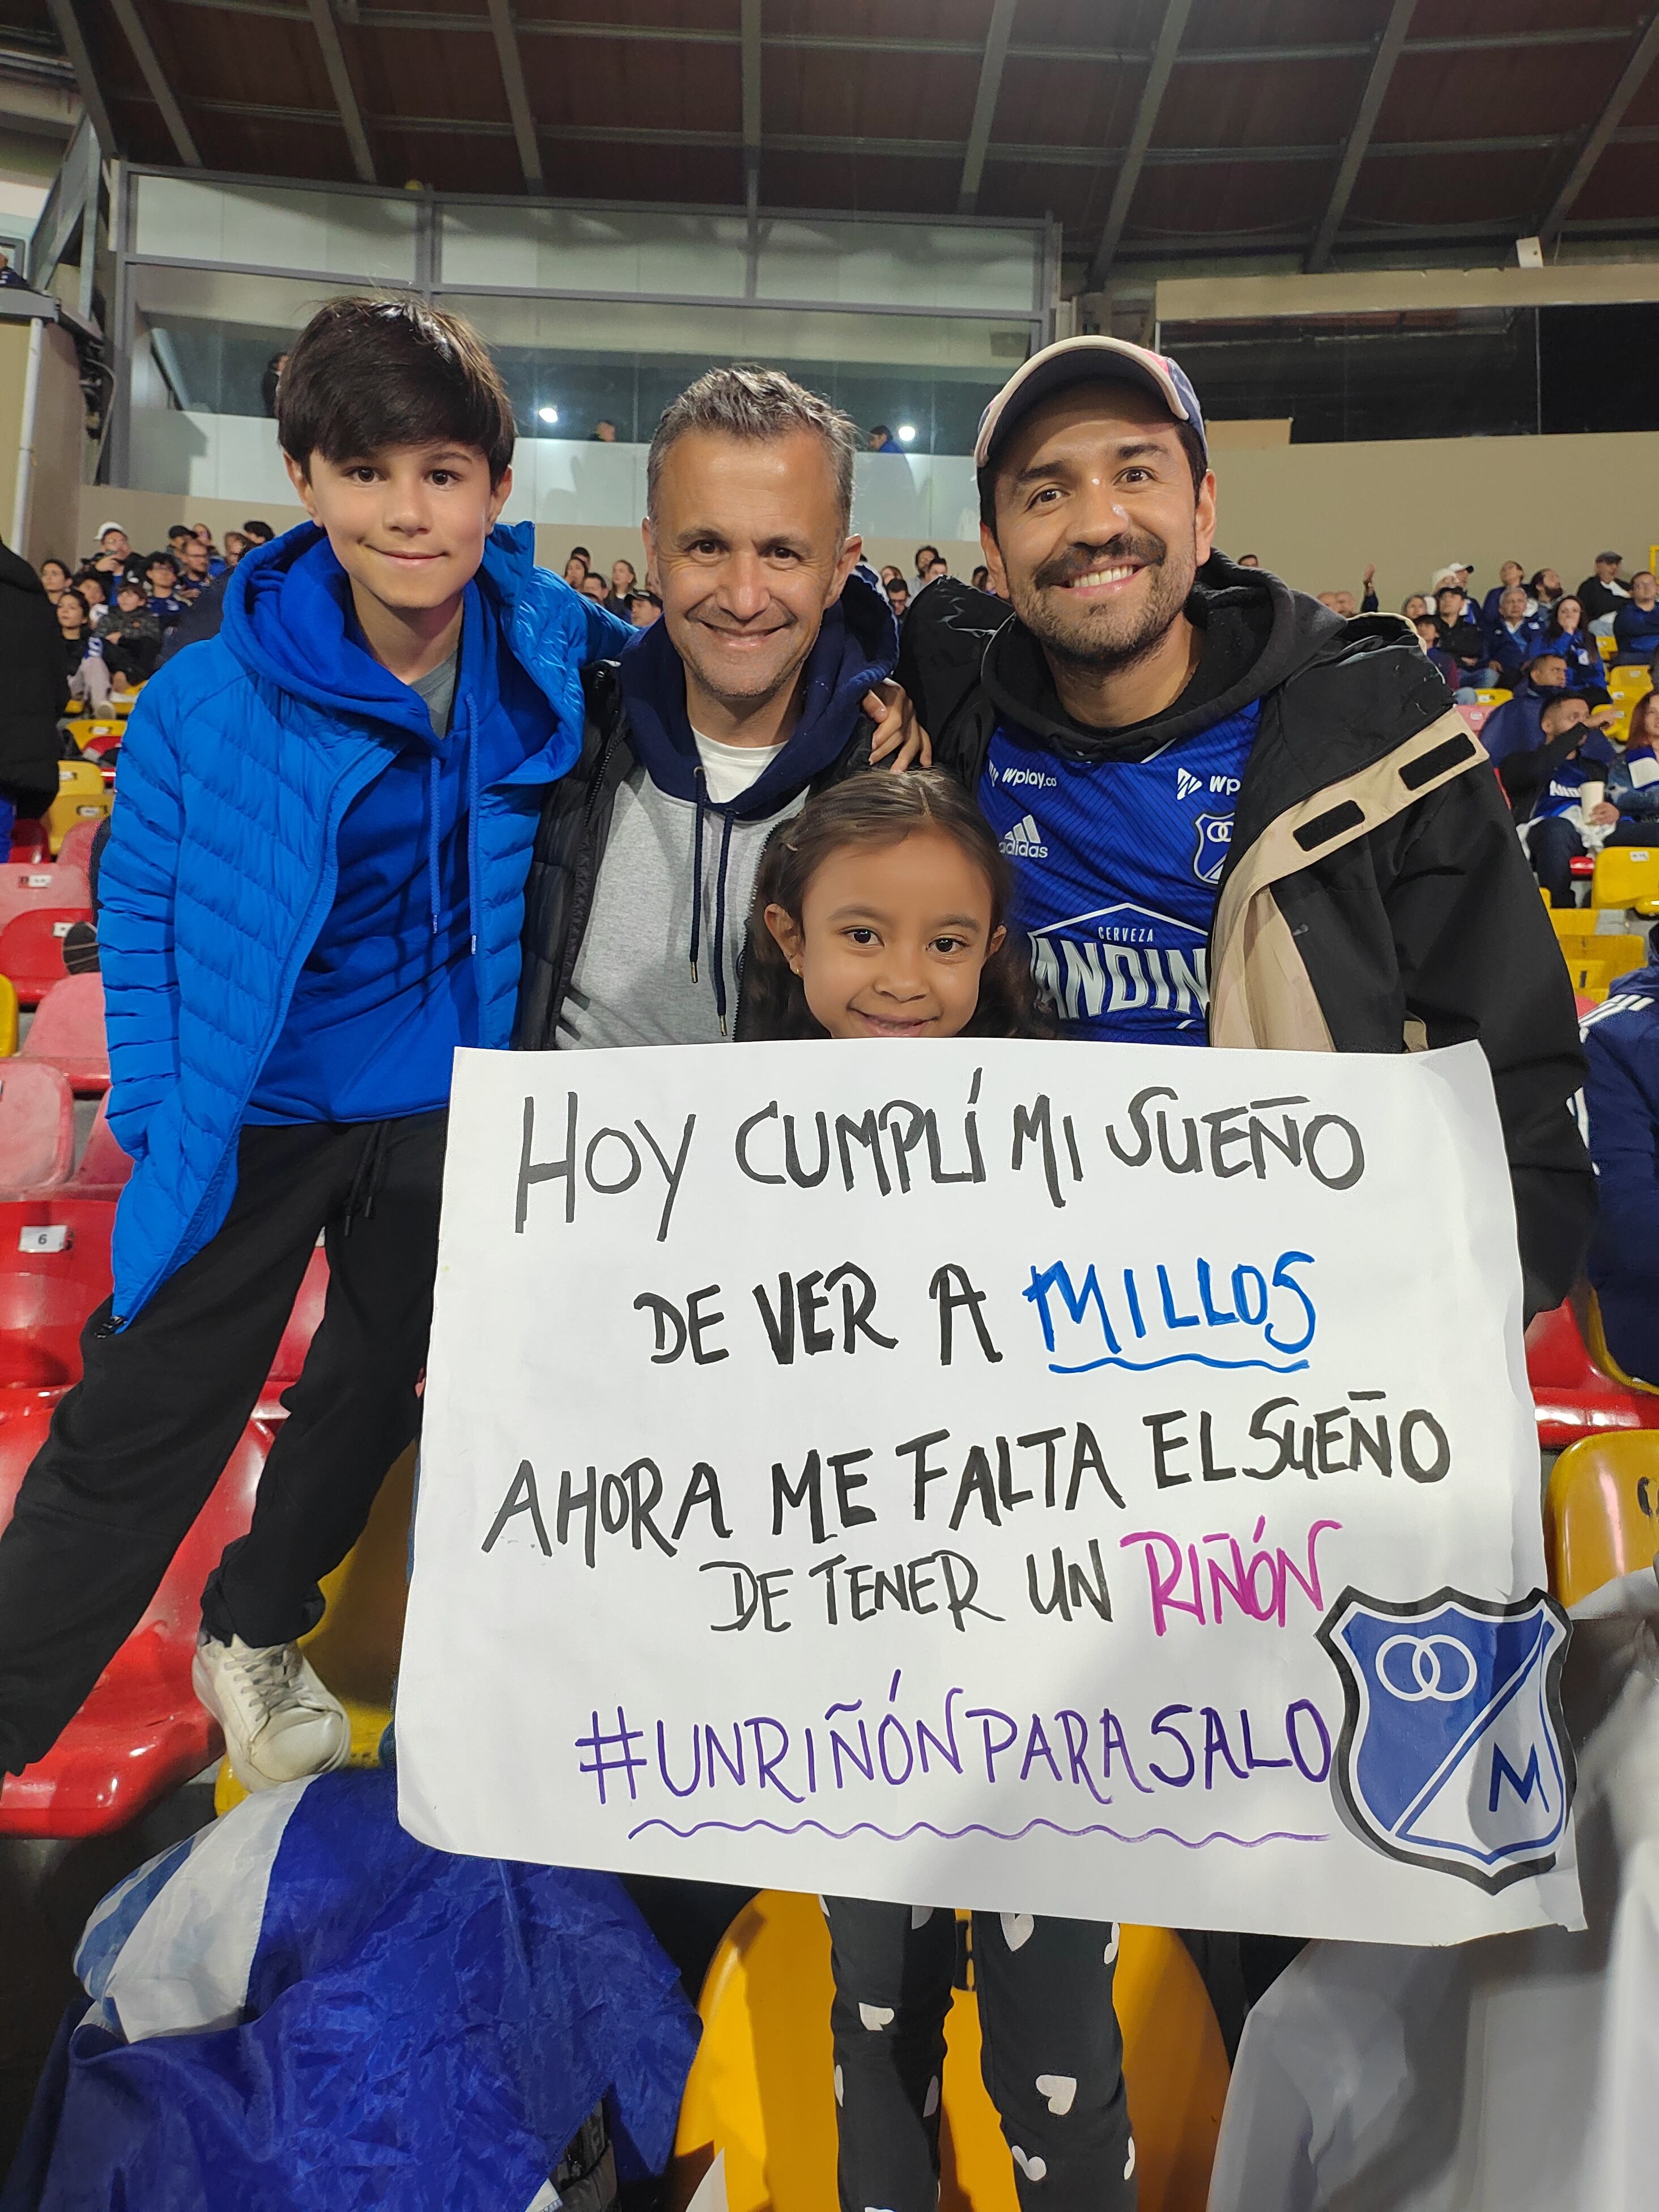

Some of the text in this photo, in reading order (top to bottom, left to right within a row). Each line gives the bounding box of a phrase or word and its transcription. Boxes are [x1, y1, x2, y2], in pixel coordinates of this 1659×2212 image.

[998, 840, 1048, 858] adidas
[1098, 926, 1154, 943] CERVEZA
[515, 1067, 1366, 1243] HOY CUMPLÍ MI SUEÑO
[37, 1233, 48, 1245] 6
[633, 1250, 1316, 1366] DE VER A MILLOS
[481, 1457, 734, 1569] AHORA
[771, 1448, 877, 1544] ME
[895, 1422, 1126, 1531] FALTA
[1142, 1410, 1237, 1490] EL
[699, 1515, 1344, 1637] DE TENER UN RIÑÓN
[575, 1669, 1332, 1804] #UNRIÑÓNPARASALO
[1488, 1742, 1550, 1814] M
